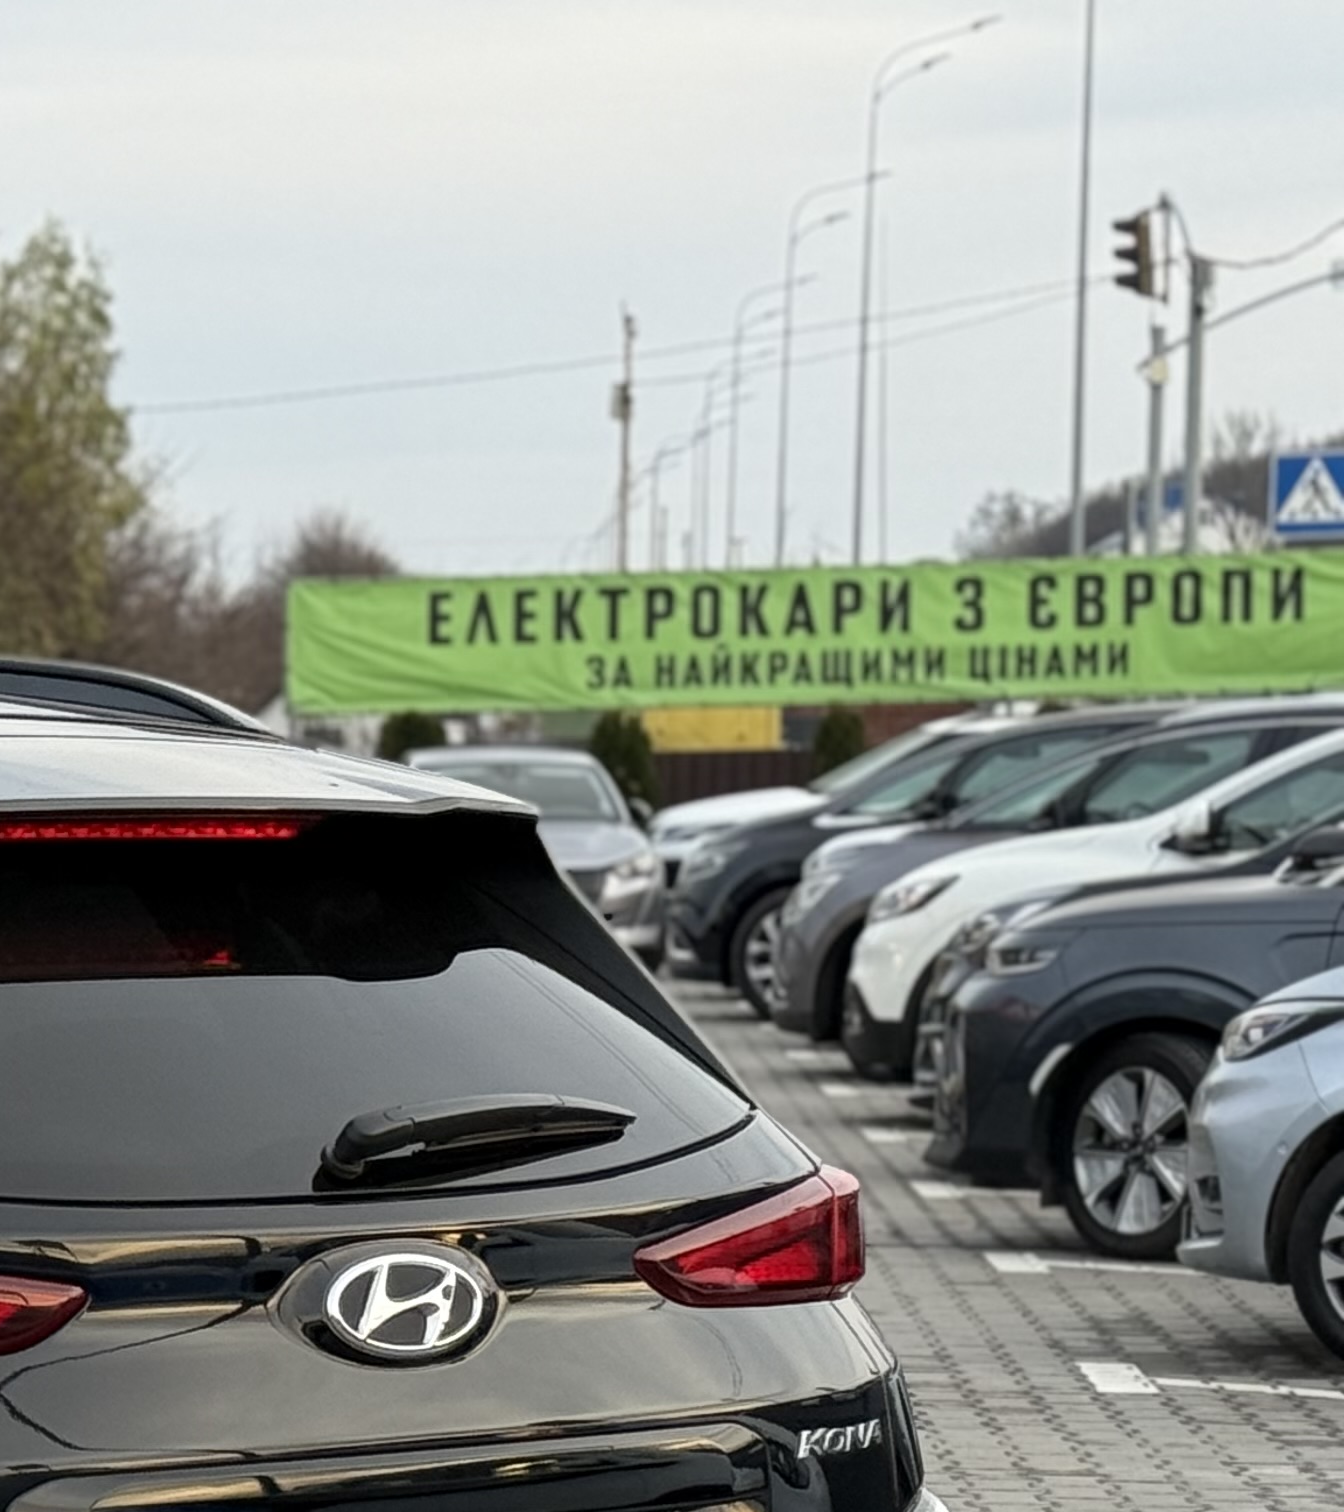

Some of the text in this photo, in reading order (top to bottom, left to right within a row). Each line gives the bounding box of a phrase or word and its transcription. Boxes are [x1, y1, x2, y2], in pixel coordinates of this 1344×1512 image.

[428, 568, 1304, 646] ЕЛЕКТРОКАРИ З ЄВРОПИ
[585, 640, 1129, 691] ЗА НАЙКРАЩИМИ ЦІНАМИ
